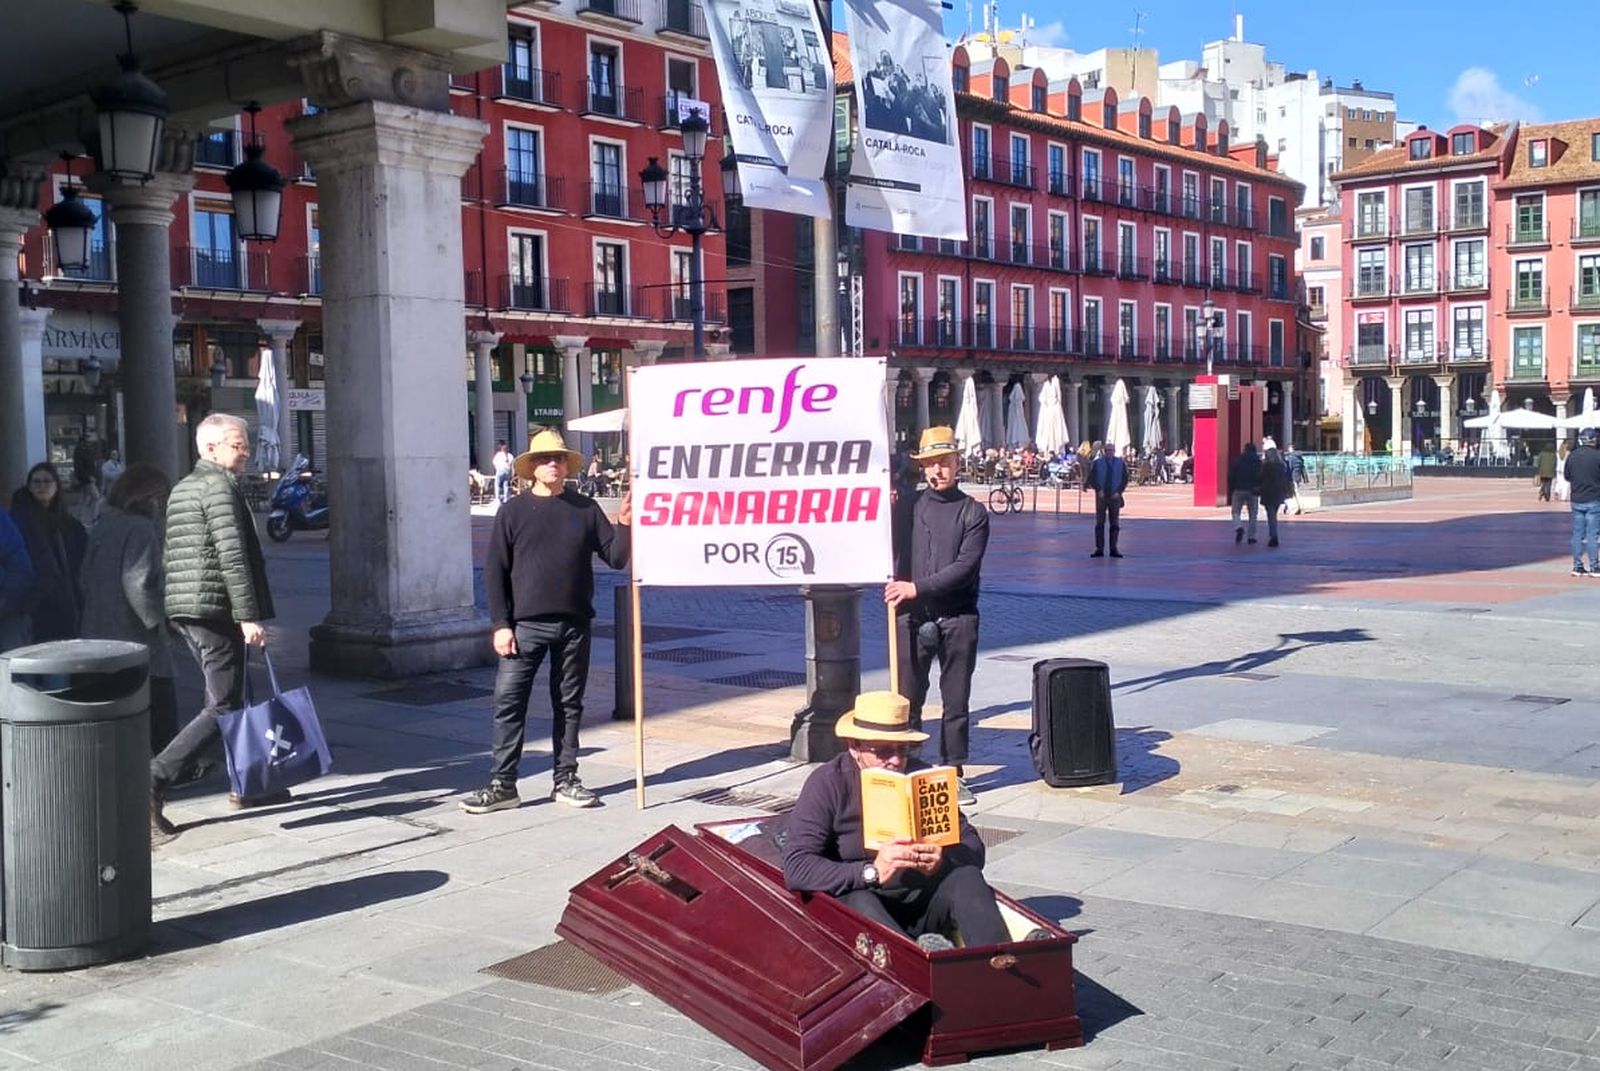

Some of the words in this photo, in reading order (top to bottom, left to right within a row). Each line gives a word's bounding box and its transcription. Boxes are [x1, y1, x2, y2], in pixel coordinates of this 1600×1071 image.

[865, 137, 926, 157] CATALÀ-ROCA
[42, 329, 120, 349] ARMACI
[673, 365, 838, 433] renfe
[648, 440, 872, 479] ENTIERRA
[640, 487, 881, 526] SANABRIA
[704, 543, 760, 564] POR
[776, 546, 798, 565] 15
[919, 782, 948, 795] CAM
[919, 792, 949, 808] BIO
[933, 806, 950, 814] 100
[920, 814, 950, 827] PALA
[921, 824, 950, 837] BRAS
